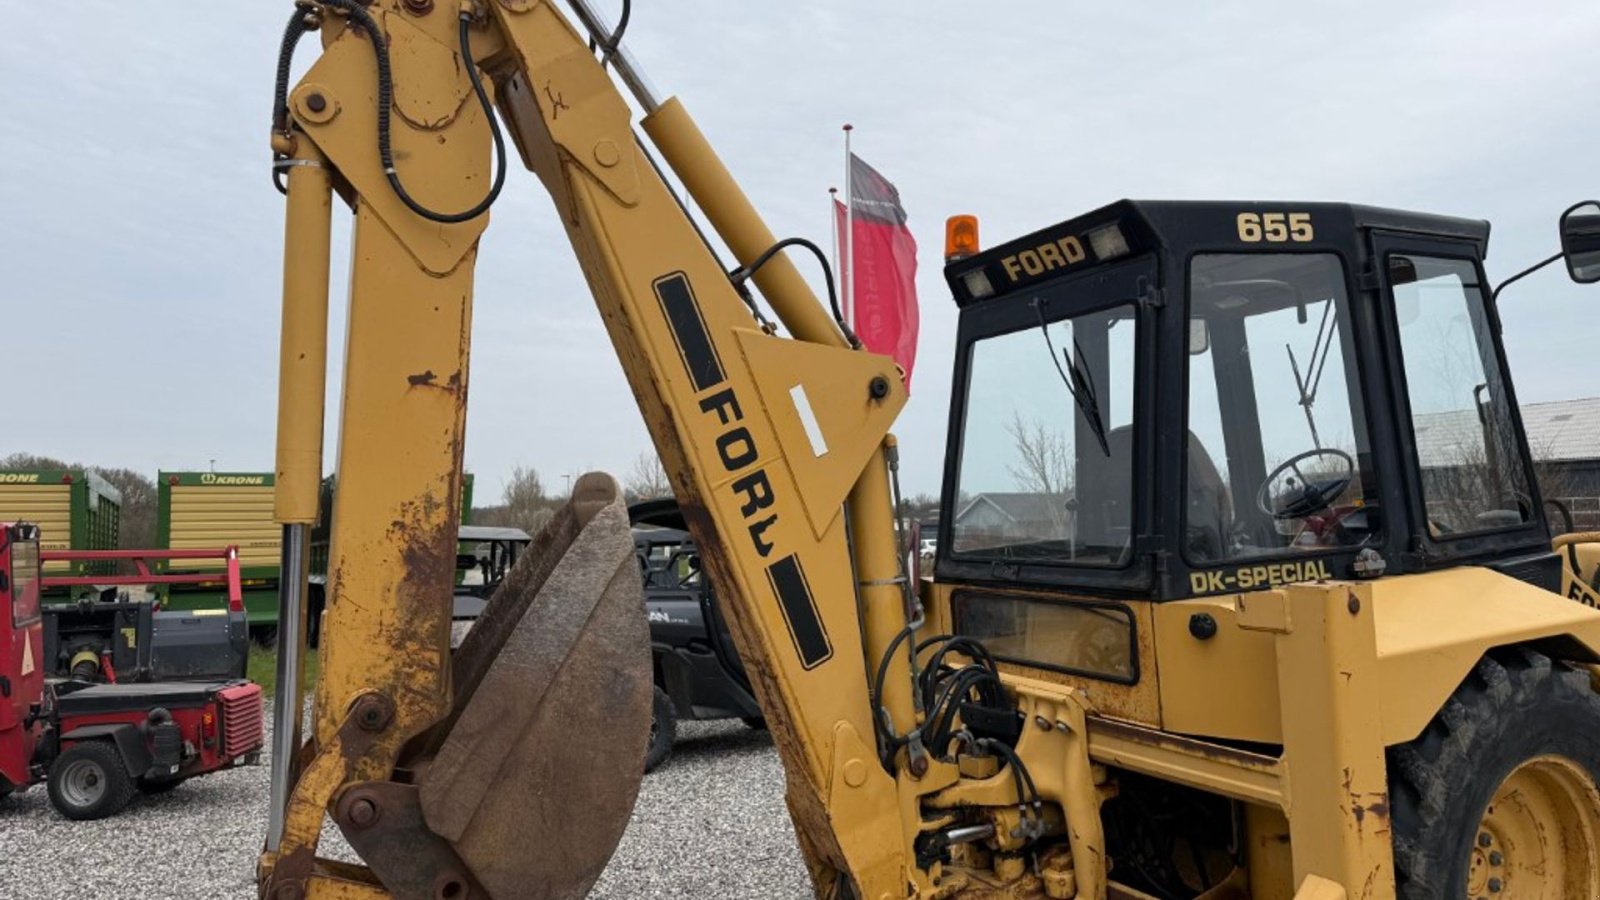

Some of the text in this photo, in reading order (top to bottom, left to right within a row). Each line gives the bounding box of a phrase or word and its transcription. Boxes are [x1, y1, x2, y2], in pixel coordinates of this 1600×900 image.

[1236, 212, 1314, 242] 655
[1001, 235, 1086, 282] FORD
[215, 476, 264, 484] KRONE
[1189, 560, 1332, 594] DK-SPECIAL
